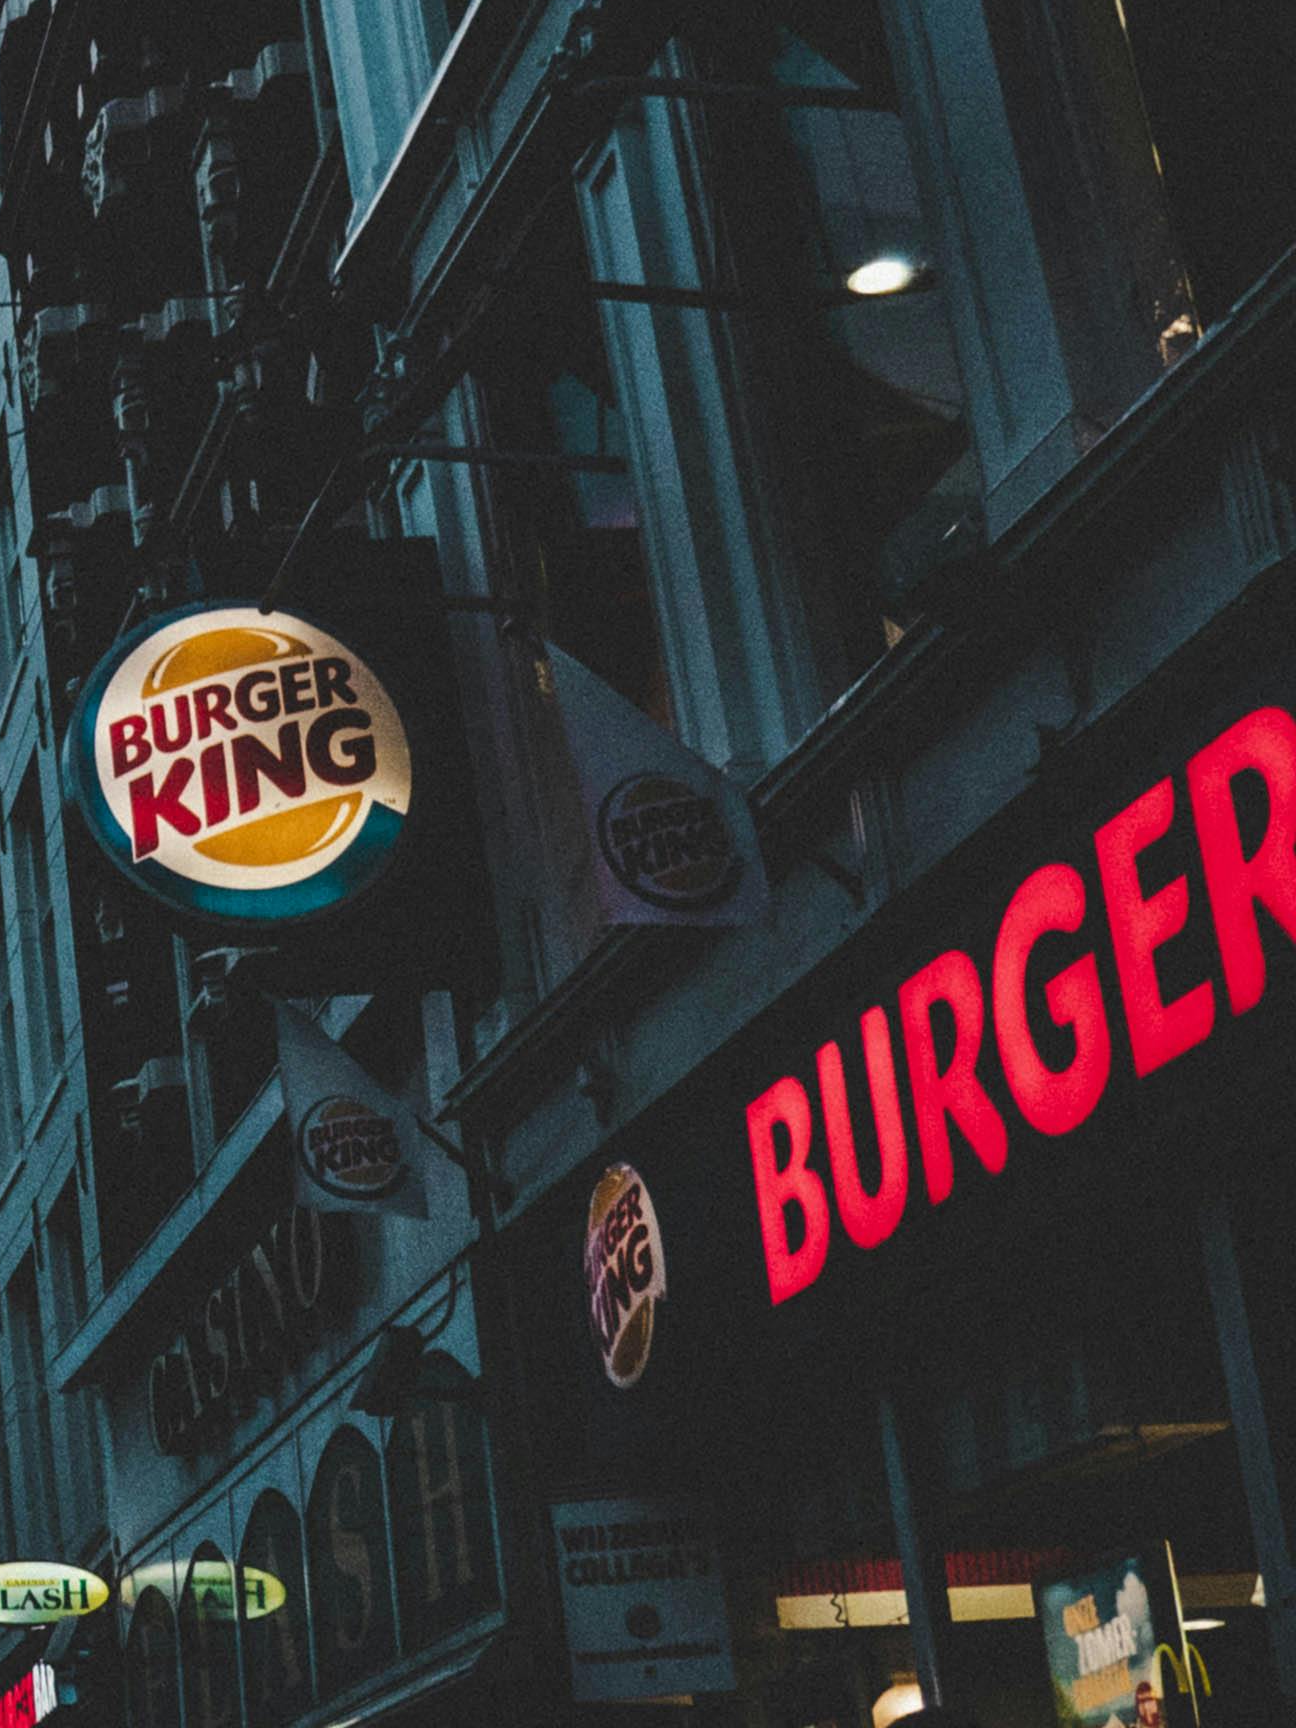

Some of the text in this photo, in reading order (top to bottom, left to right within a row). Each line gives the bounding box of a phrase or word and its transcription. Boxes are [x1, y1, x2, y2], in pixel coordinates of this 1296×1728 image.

[109, 656, 358, 779] BURGER
[129, 707, 378, 860] KING
[747, 705, 1296, 1306] BURGER
